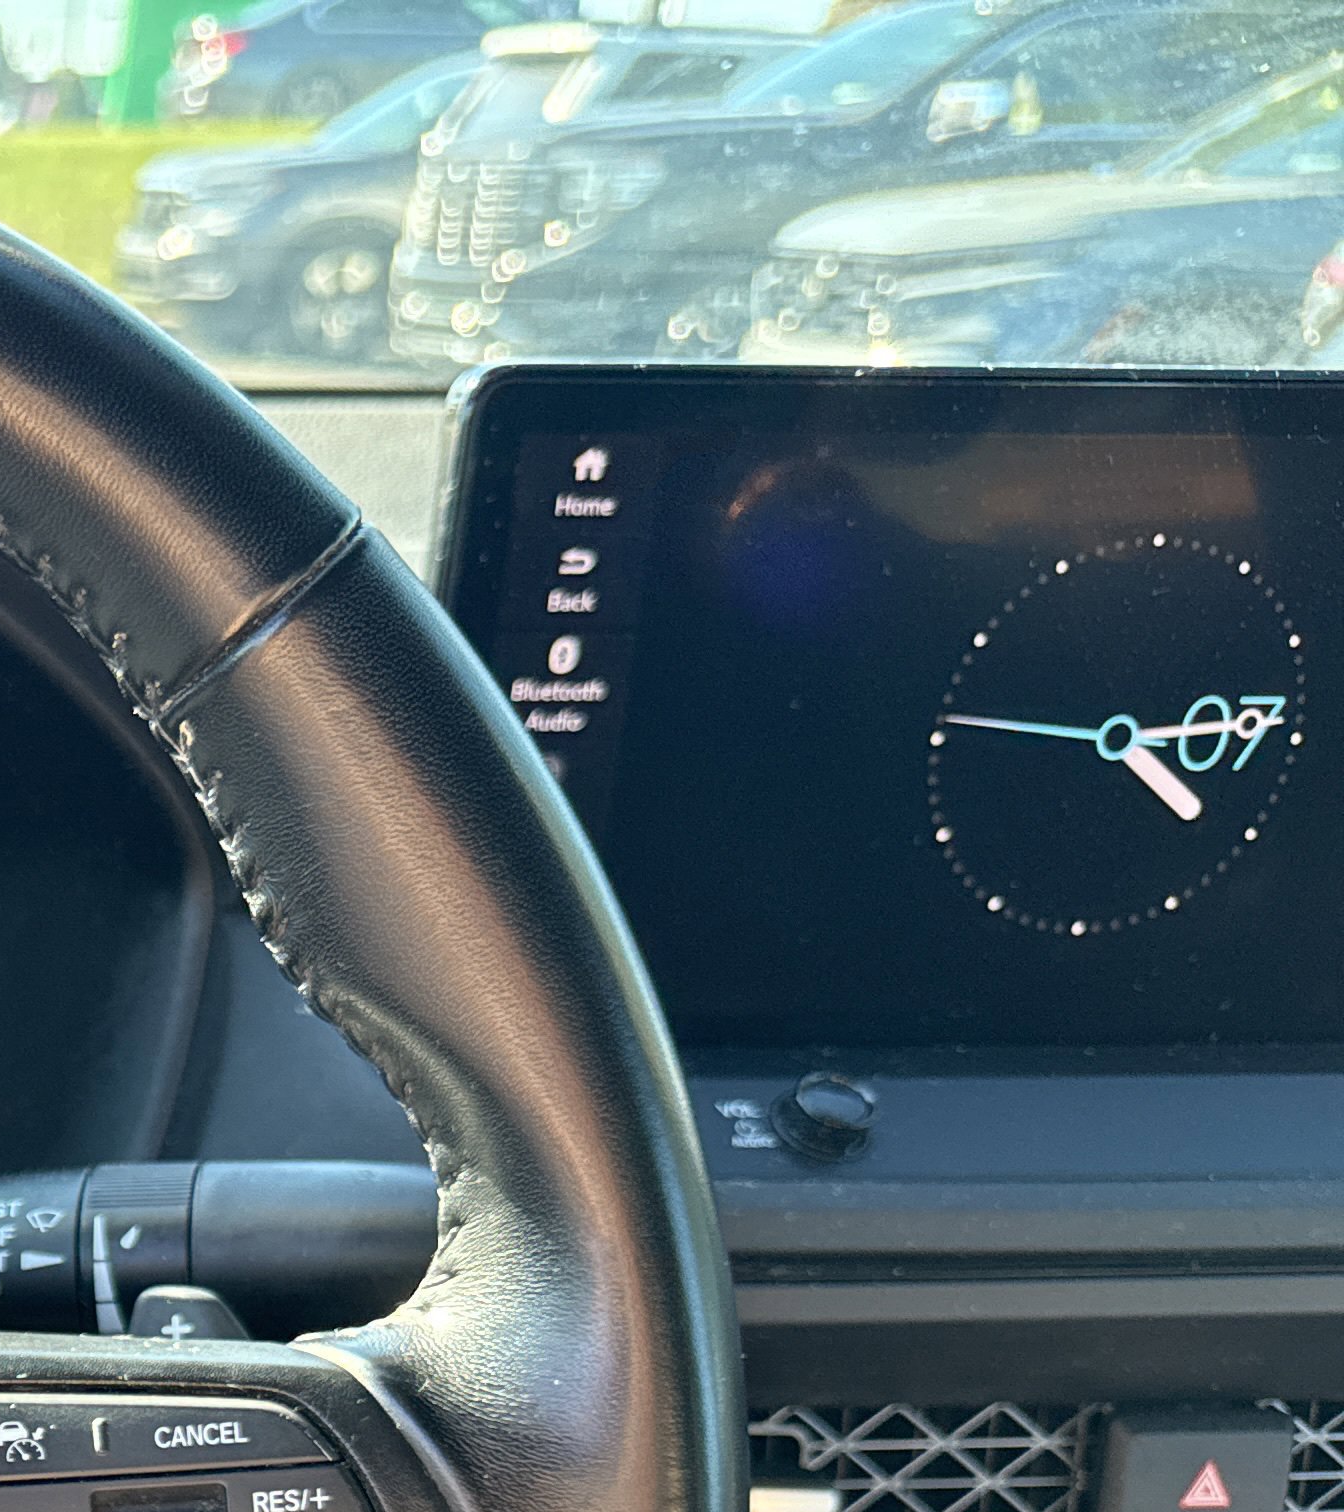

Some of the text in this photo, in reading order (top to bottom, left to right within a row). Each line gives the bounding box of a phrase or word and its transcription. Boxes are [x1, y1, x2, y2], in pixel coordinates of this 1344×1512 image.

[553, 493, 617, 517] Home
[546, 587, 599, 613] Back
[511, 677, 610, 702] Bluetooth
[524, 708, 589, 732] Audio
[153, 1421, 249, 1449] CANCEL
